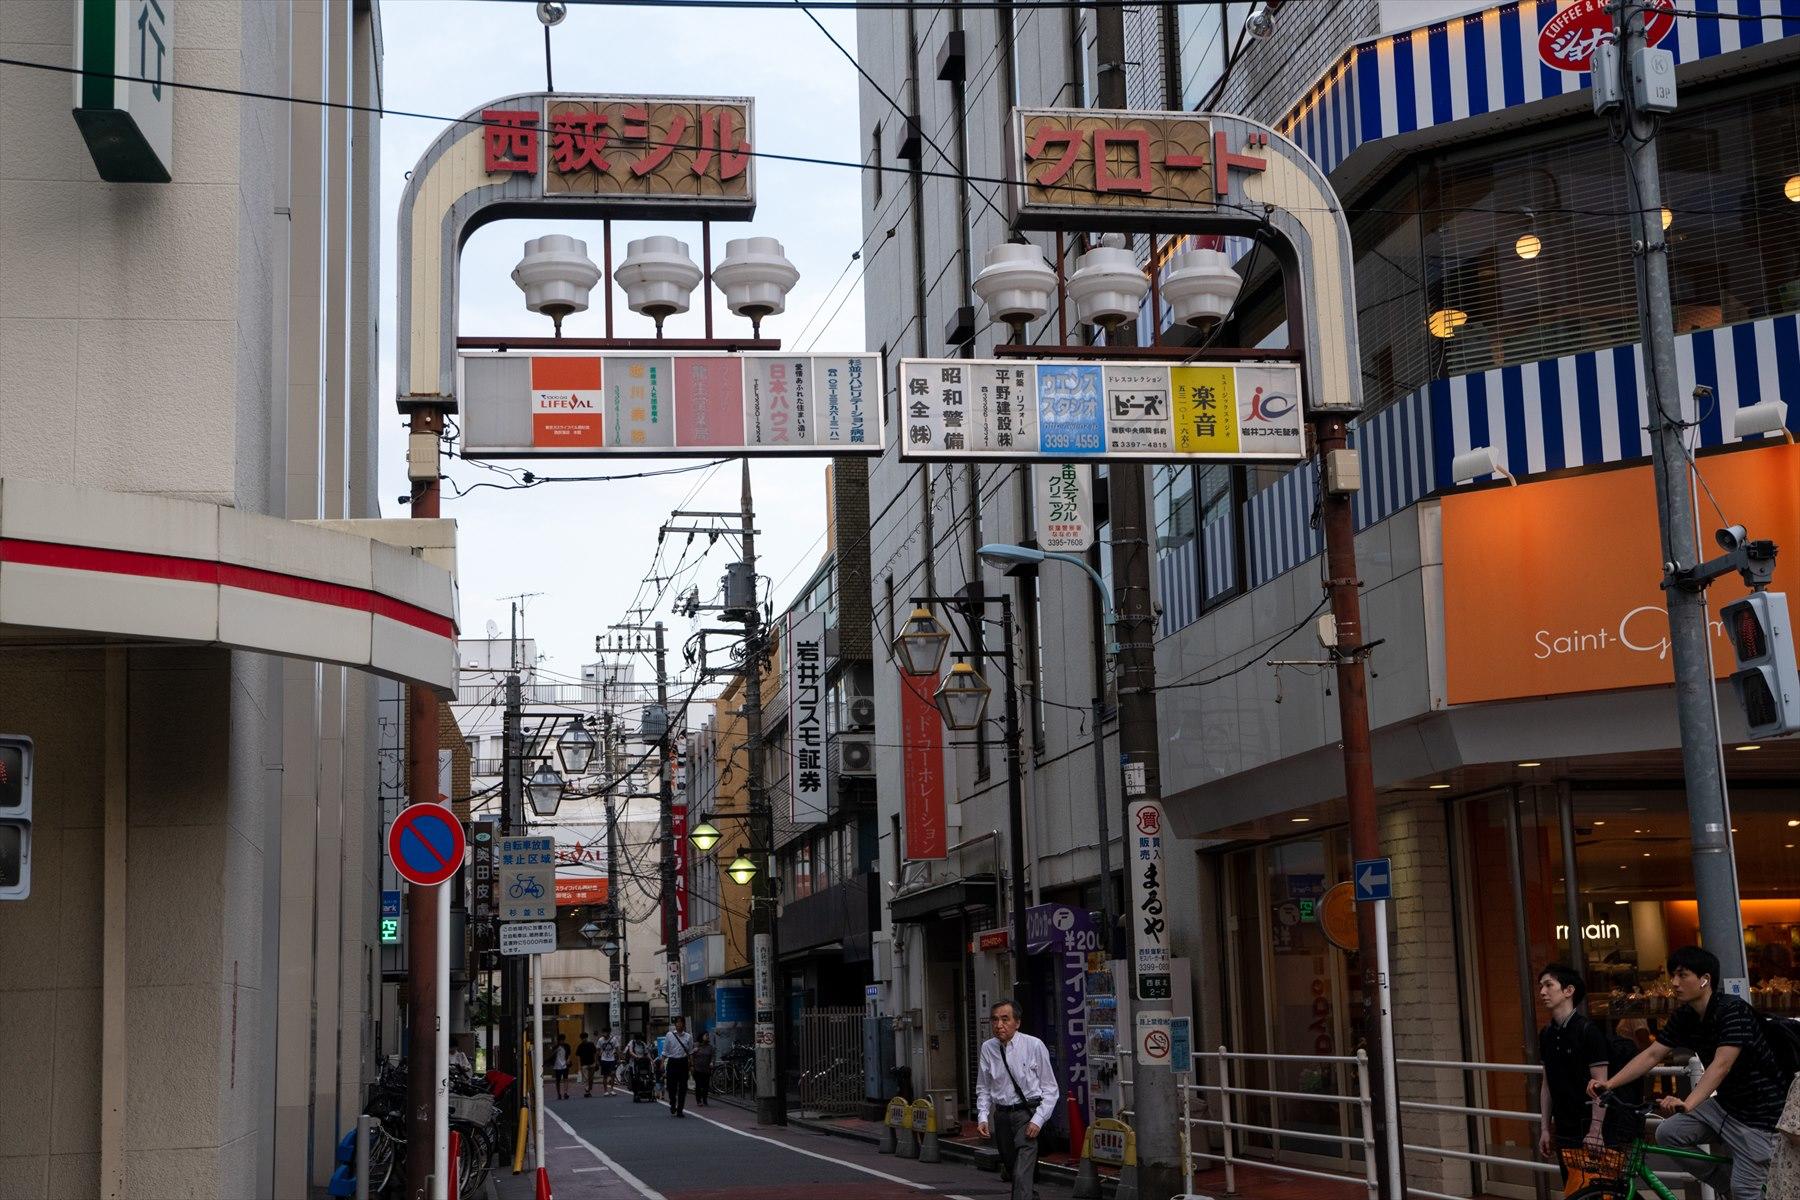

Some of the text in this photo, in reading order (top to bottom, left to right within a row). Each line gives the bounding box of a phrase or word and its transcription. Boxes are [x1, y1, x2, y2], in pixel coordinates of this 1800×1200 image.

[1545, 8, 1584, 38] COFFEE
[482, 107, 750, 180] 西荻シル
[1025, 126, 1267, 195] クロード
[541, 397, 594, 410] LIFEVAL
[770, 364, 790, 441] 日本ハウス
[848, 359, 864, 442] 杉並リハビリテーション病院
[942, 367, 964, 450] 昭和警備
[1114, 393, 1163, 416] ビーズ
[1191, 385, 1217, 438] 楽音
[1044, 434, 1100, 449] 3399-4558
[1242, 427, 1299, 437] 岩井コスモ証券
[1049, 476, 1063, 522] クリニック
[797, 640, 822, 793] 岩井コスモ証券
[1142, 812, 1157, 829] 質
[502, 854, 551, 865] 禁止区域
[503, 841, 551, 851] 自転車放置
[1140, 837, 1150, 861] 販売
[1141, 862, 1165, 944] まるや
[1065, 951, 1090, 1105] コインロッカー
